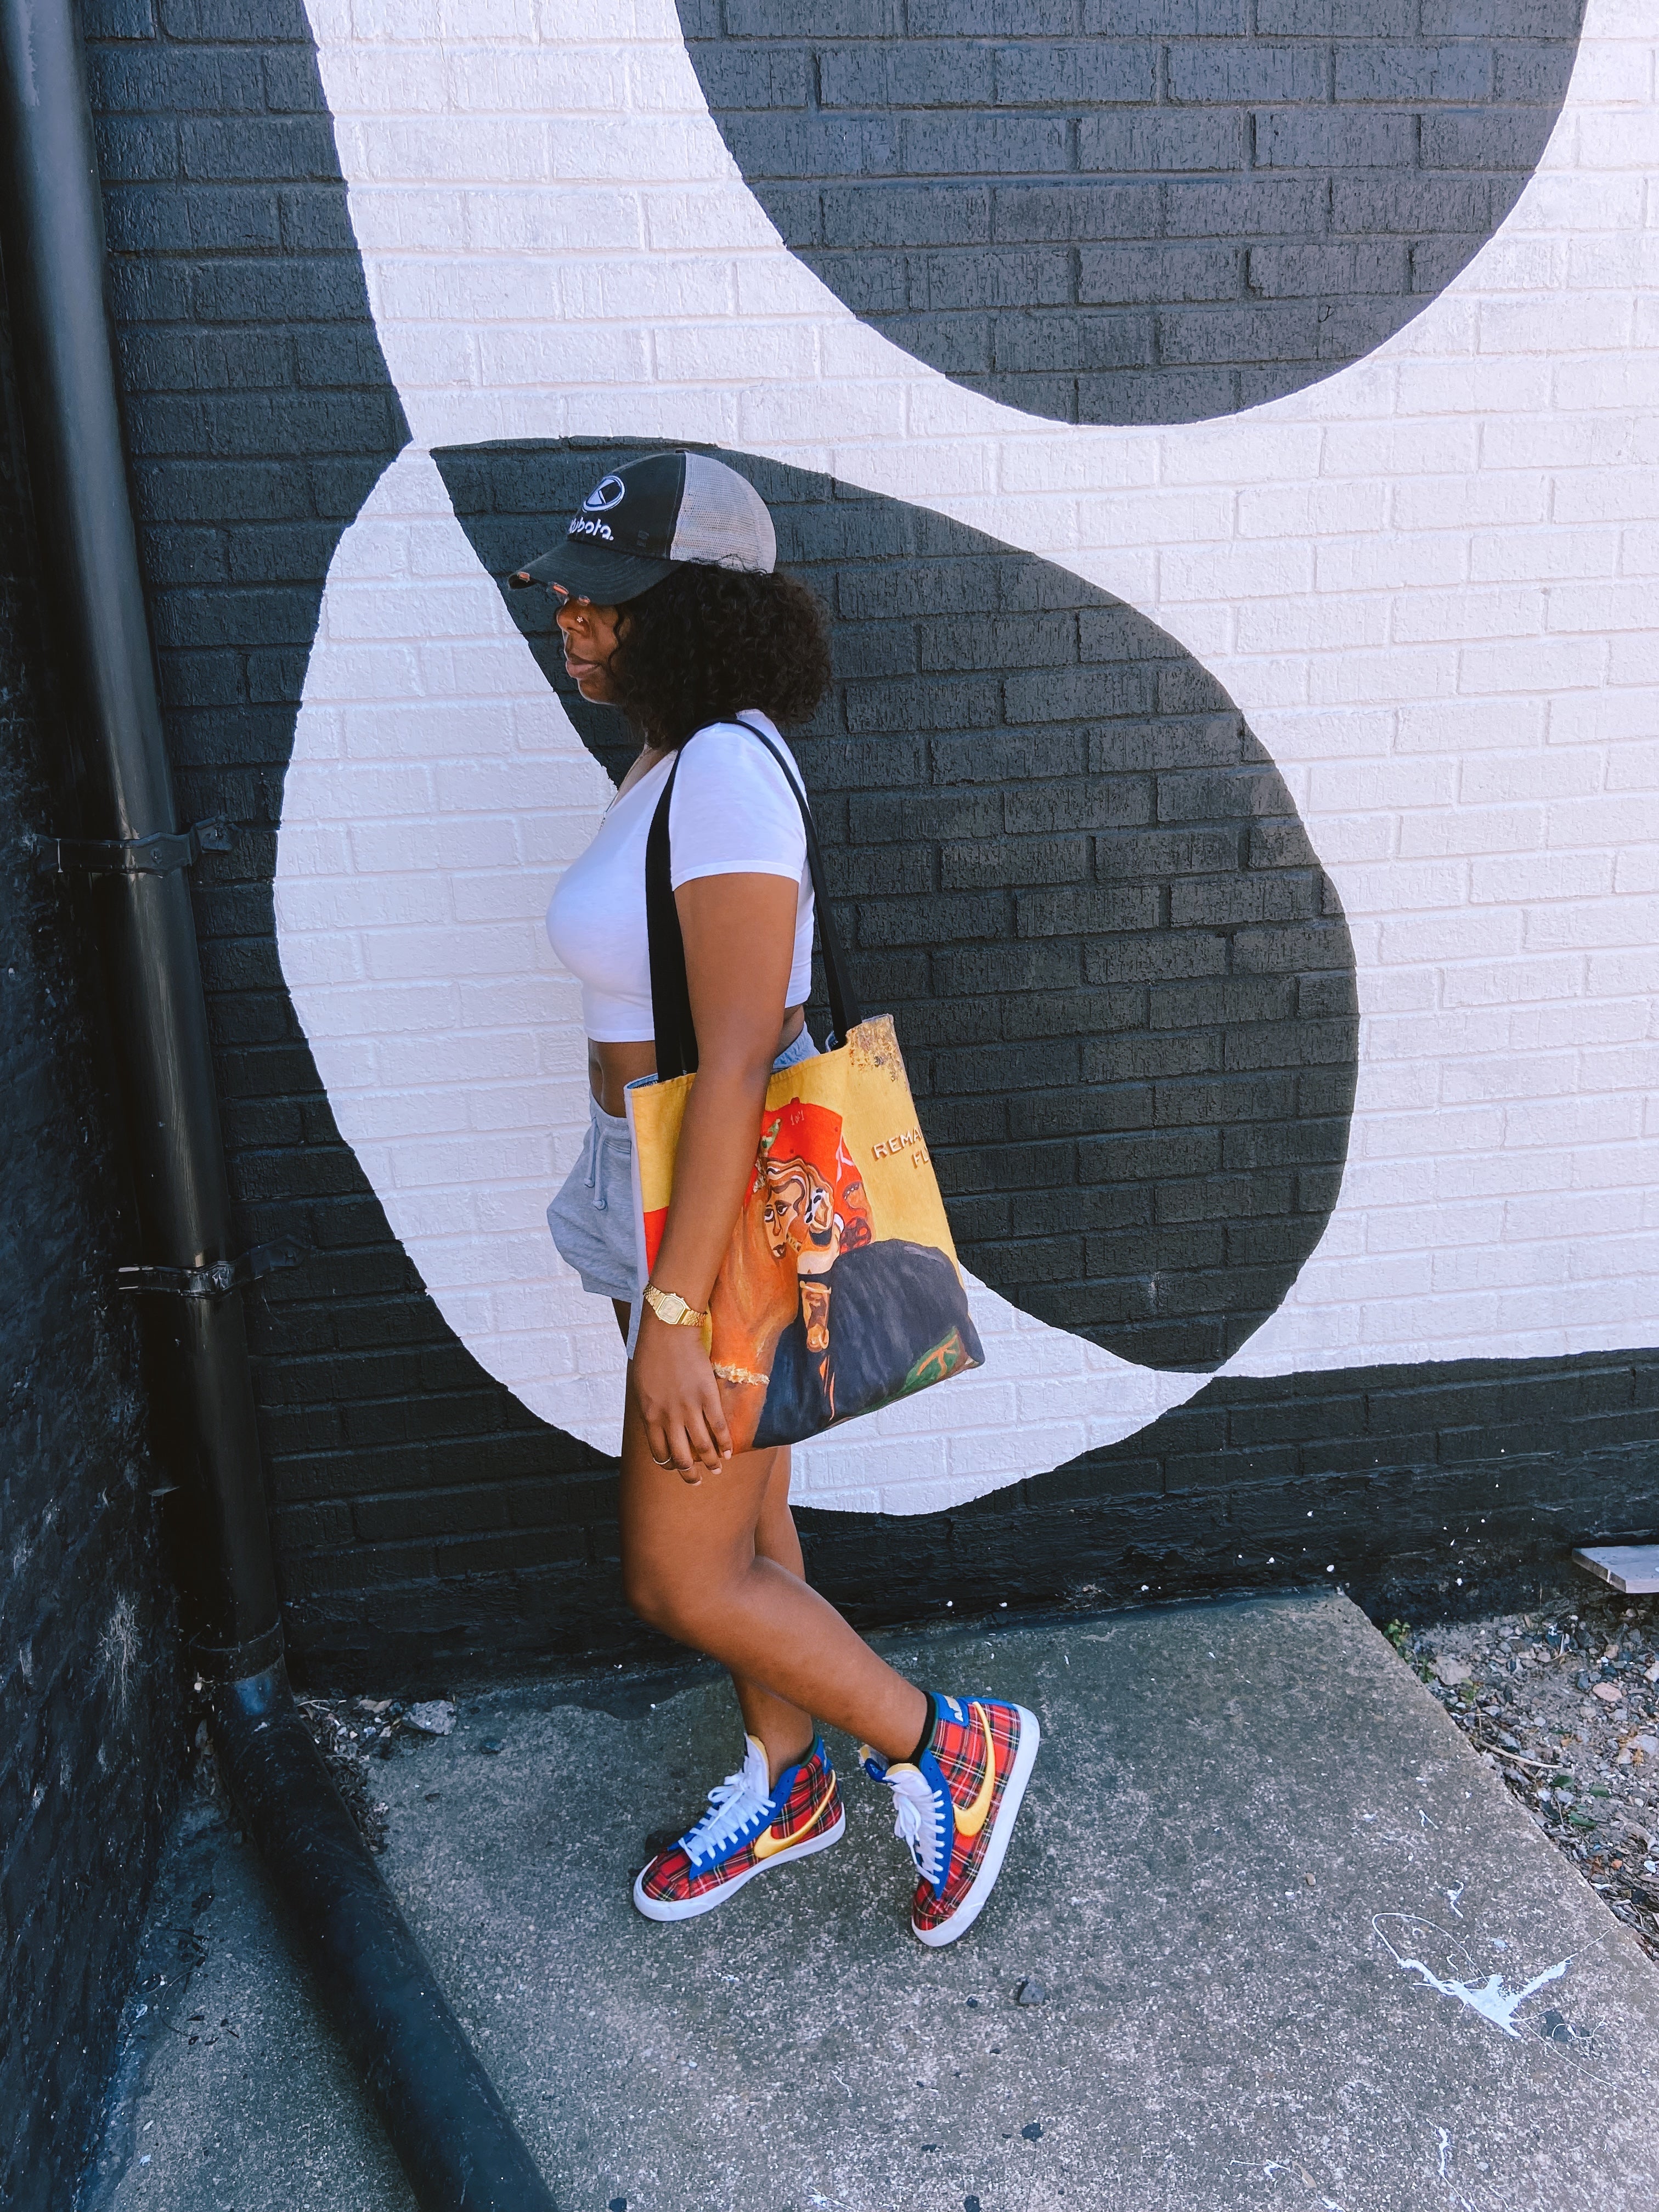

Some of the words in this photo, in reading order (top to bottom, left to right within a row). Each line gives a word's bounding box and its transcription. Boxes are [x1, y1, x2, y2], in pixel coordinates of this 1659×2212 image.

[791, 1114, 794, 1125] 1
[801, 1110, 804, 1121] 1
[911, 1146, 929, 1169] FL
